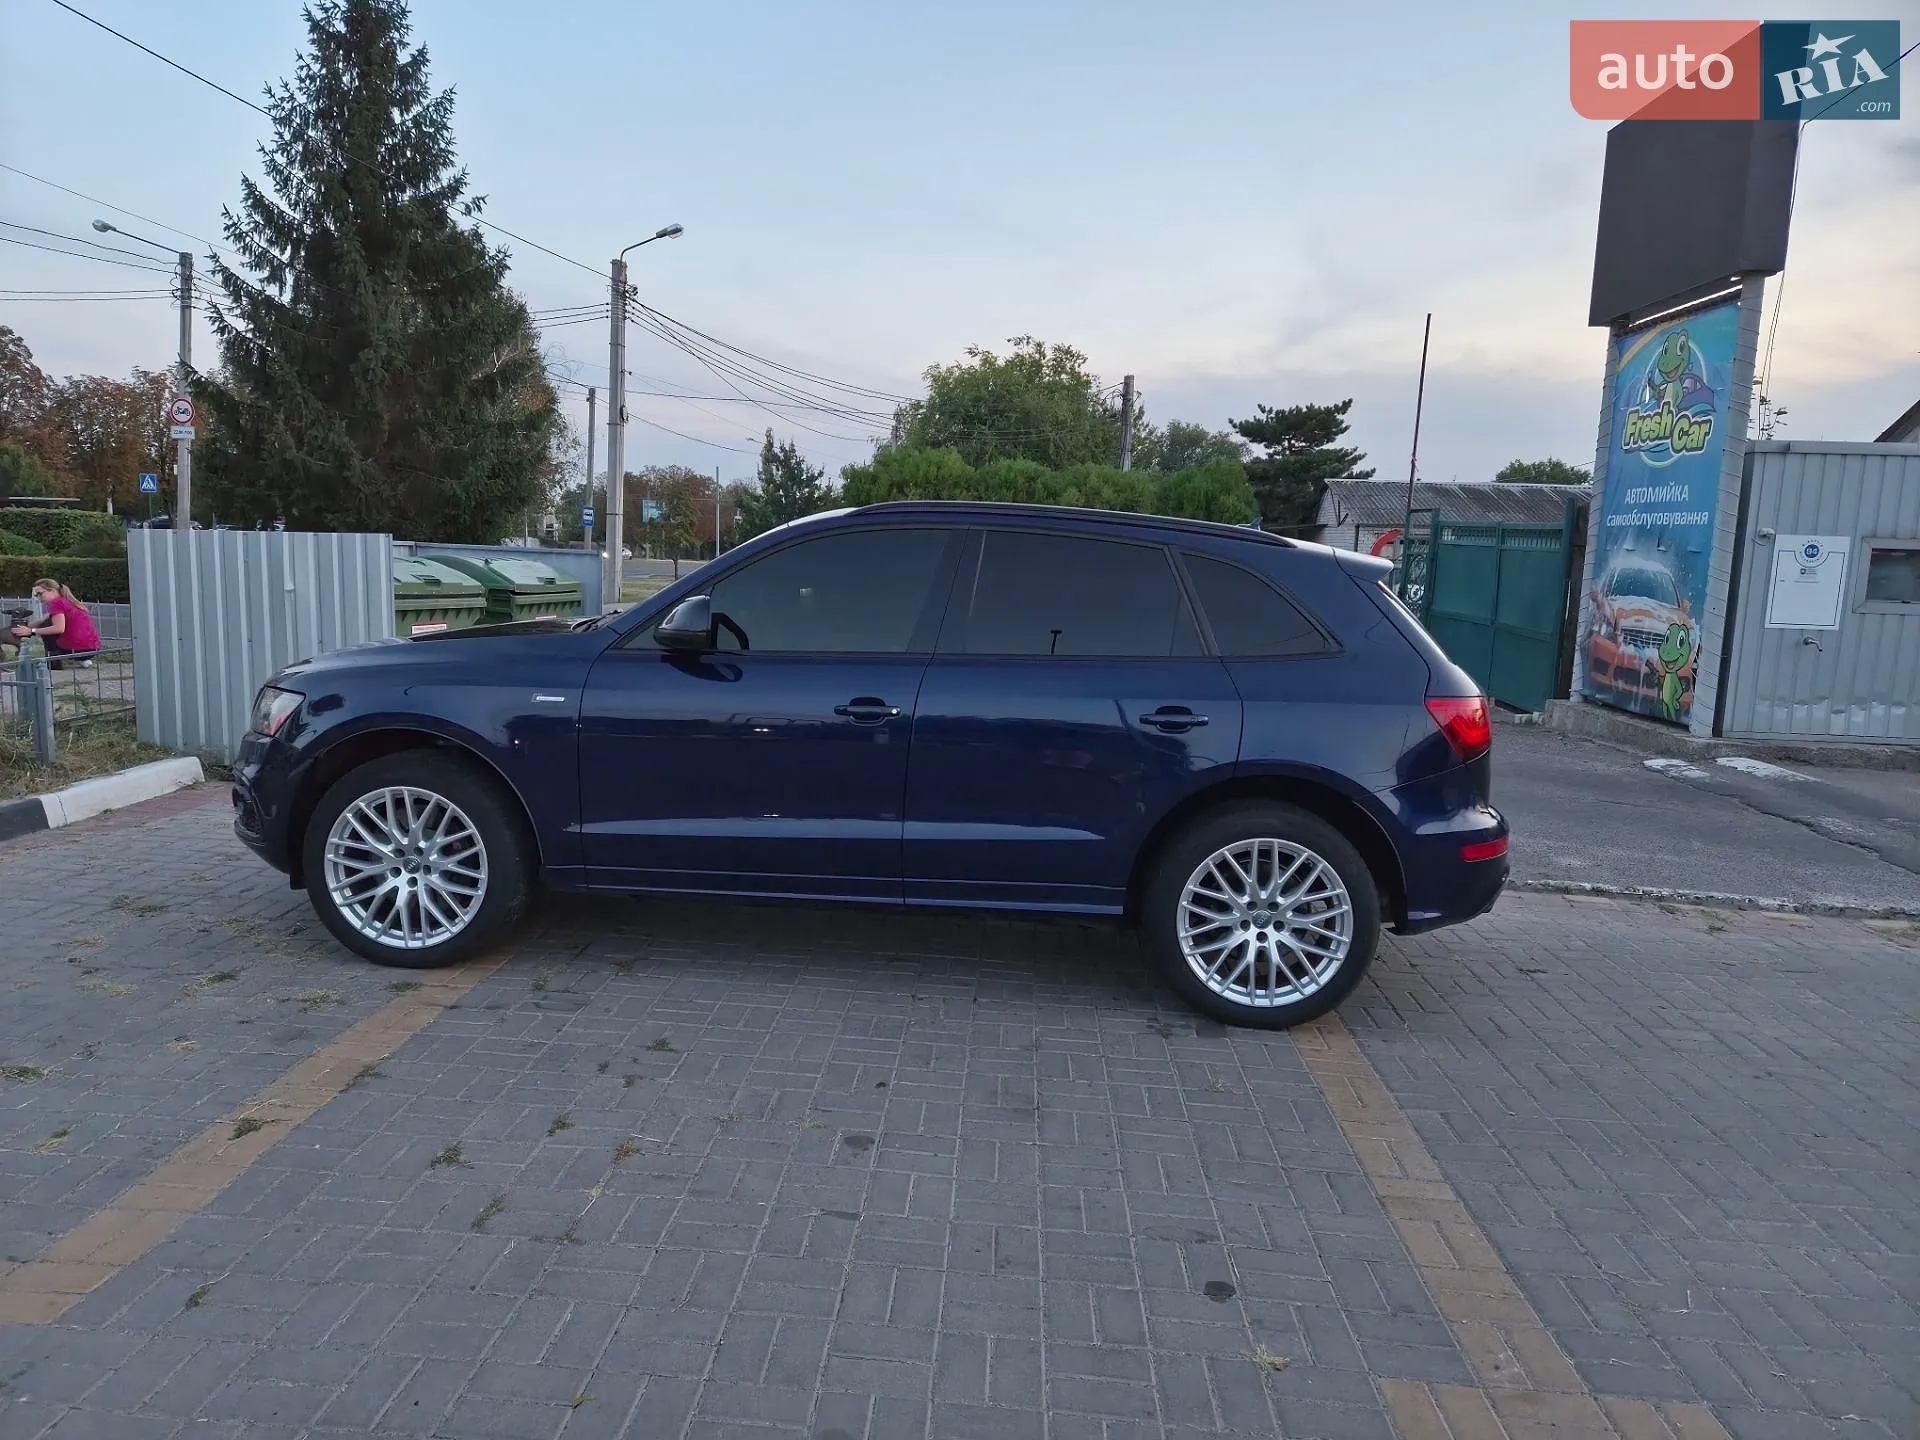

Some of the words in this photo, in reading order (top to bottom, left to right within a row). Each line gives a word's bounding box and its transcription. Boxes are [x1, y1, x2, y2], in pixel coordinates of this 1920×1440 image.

[1623, 401, 1674, 447] Fresh
[1672, 413, 1713, 454] Car
[1624, 481, 1689, 504] АВТОМИЙКА
[1606, 509, 1709, 529] самообслуговування
